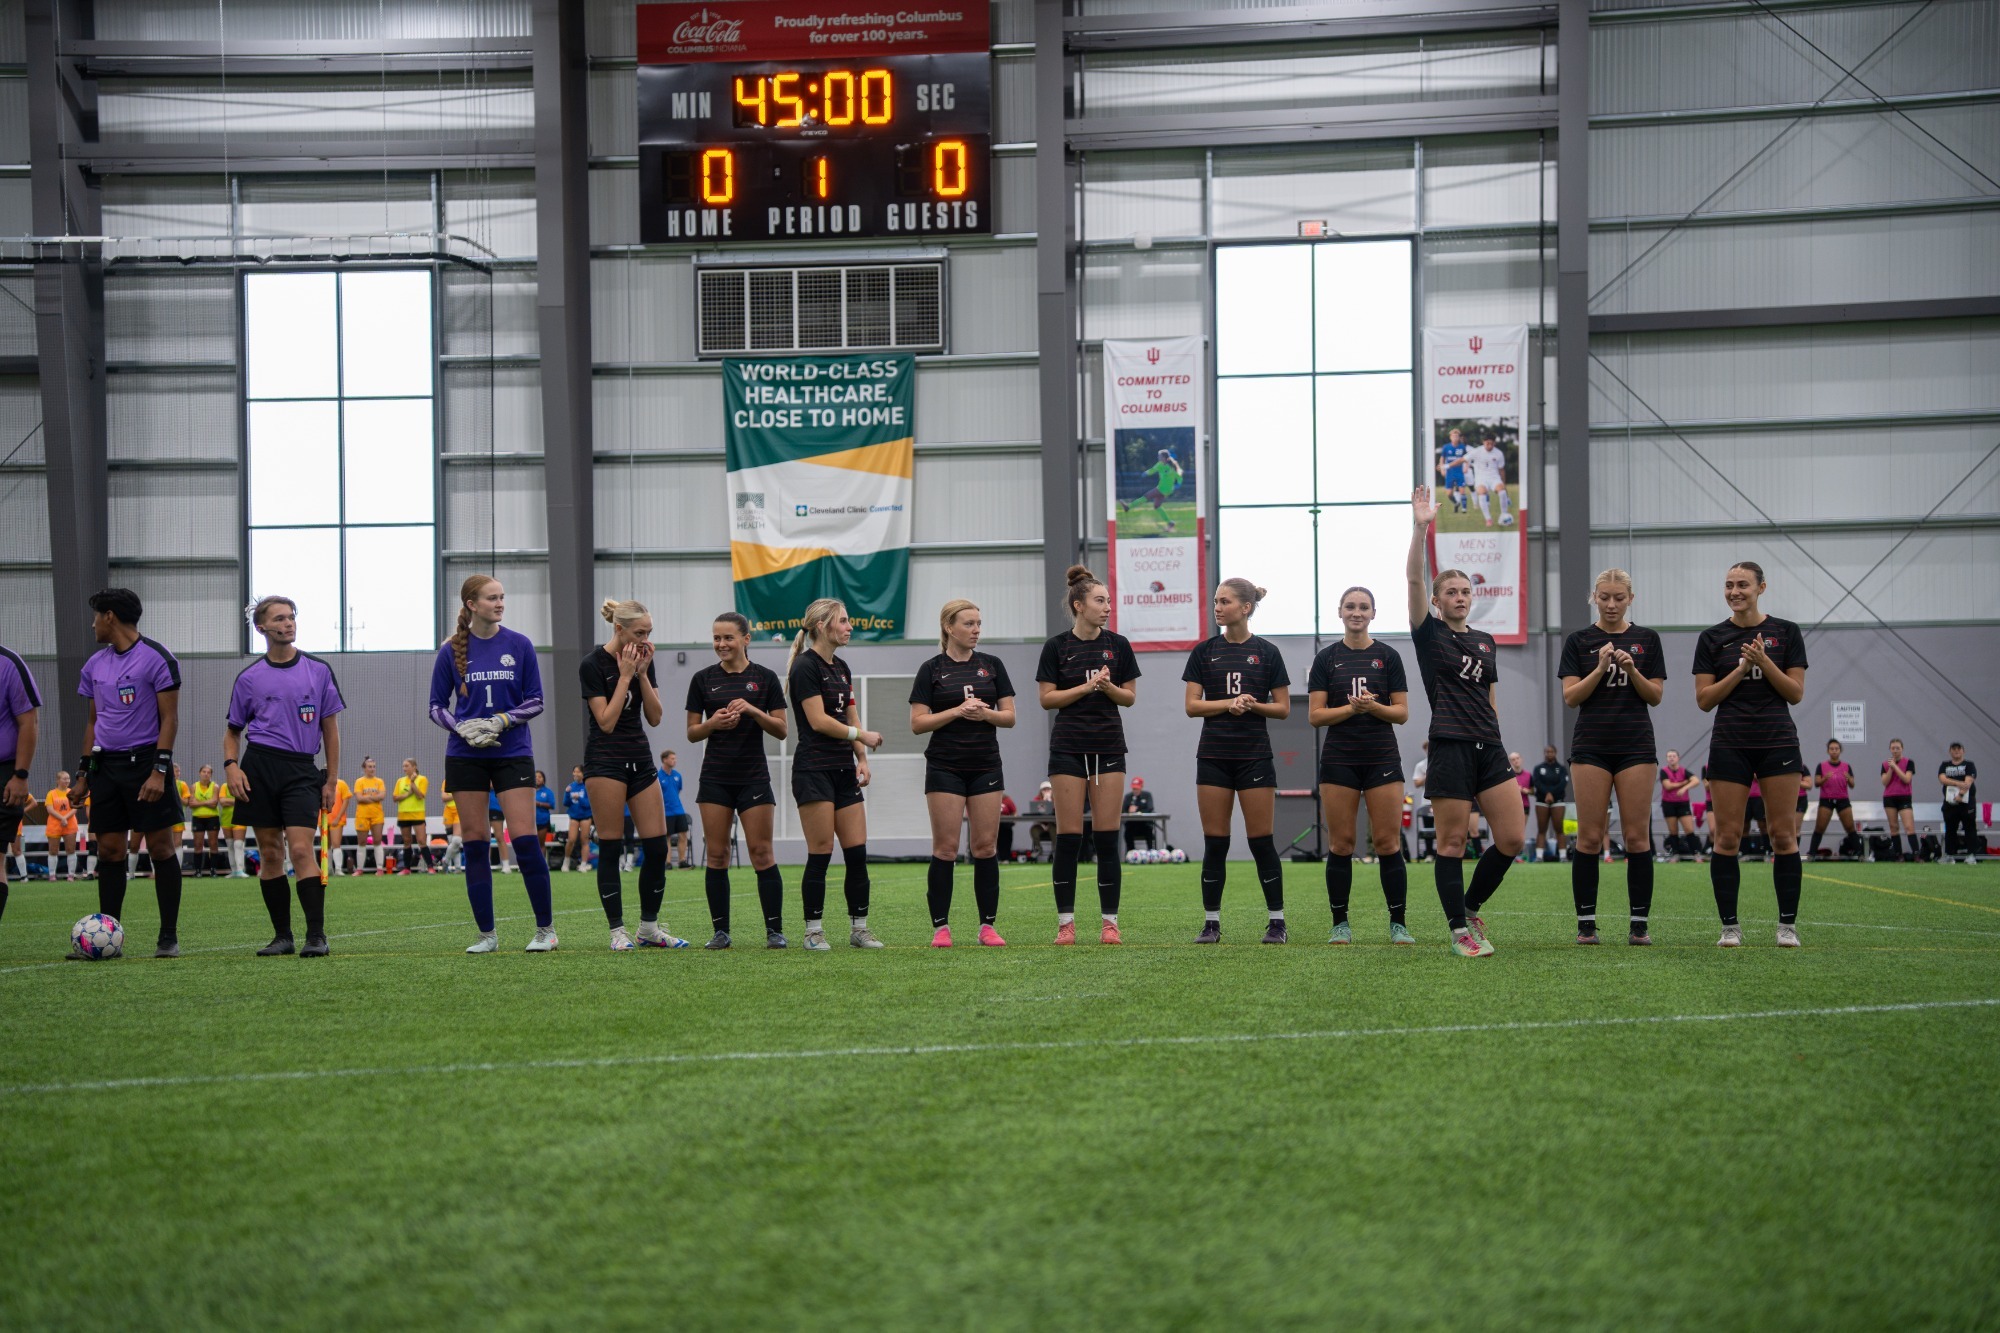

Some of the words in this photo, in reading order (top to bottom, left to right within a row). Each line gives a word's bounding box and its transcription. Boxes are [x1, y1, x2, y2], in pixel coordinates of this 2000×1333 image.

[774, 15, 826, 29] Proudly
[827, 13, 894, 27] refreshing
[896, 10, 963, 23] Columbus
[809, 31, 829, 43] for
[831, 32, 860, 43] over
[862, 30, 886, 42] 100
[887, 29, 928, 43] years.
[671, 92, 711, 120] MIN
[736, 70, 891, 127] 45:00
[916, 83, 955, 112] SEC
[703, 150, 732, 203] 0
[819, 158, 826, 198] 1
[935, 142, 966, 196] 0
[667, 208, 732, 237] HOME
[768, 204, 861, 235] PERIOD
[887, 201, 978, 231] GUESTS
[739, 360, 898, 381] WORLD-CLASS
[1438, 364, 1515, 376] COMMITTED
[1117, 374, 1191, 387] COMMITTED
[1468, 379, 1485, 390] TO
[745, 384, 893, 405] HEALTHCARE,
[1146, 389, 1162, 400] TO
[1441, 392, 1511, 404] COLUMBUS
[734, 409, 802, 429] CLOSE
[808, 408, 836, 427] TO
[842, 406, 904, 427] HOME
[1121, 402, 1187, 414] COLUMBUS
[809, 506, 845, 514] Cleveland
[847, 505, 867, 513] Clinic
[736, 521, 765, 530] HEALTH
[1129, 545, 1184, 558] WOMEN'S
[1459, 538, 1497, 549] MEN'S
[1133, 559, 1180, 572] SOCCER
[1454, 552, 1502, 564] SOCCER
[1123, 595, 1134, 605] IU
[1137, 593, 1193, 605] COLUMBUS
[1472, 586, 1513, 598] LUMBUS
[749, 619, 785, 631] Learn
[788, 618, 806, 629] mo
[471, 670, 514, 681] COLUMBUS
[1460, 655, 1483, 682] 24
[1606, 663, 1628, 687] 25
[1226, 672, 1241, 695] 13
[1351, 677, 1367, 698] 16
[485, 684, 493, 707] 1
[836, 693, 844, 712] 5
